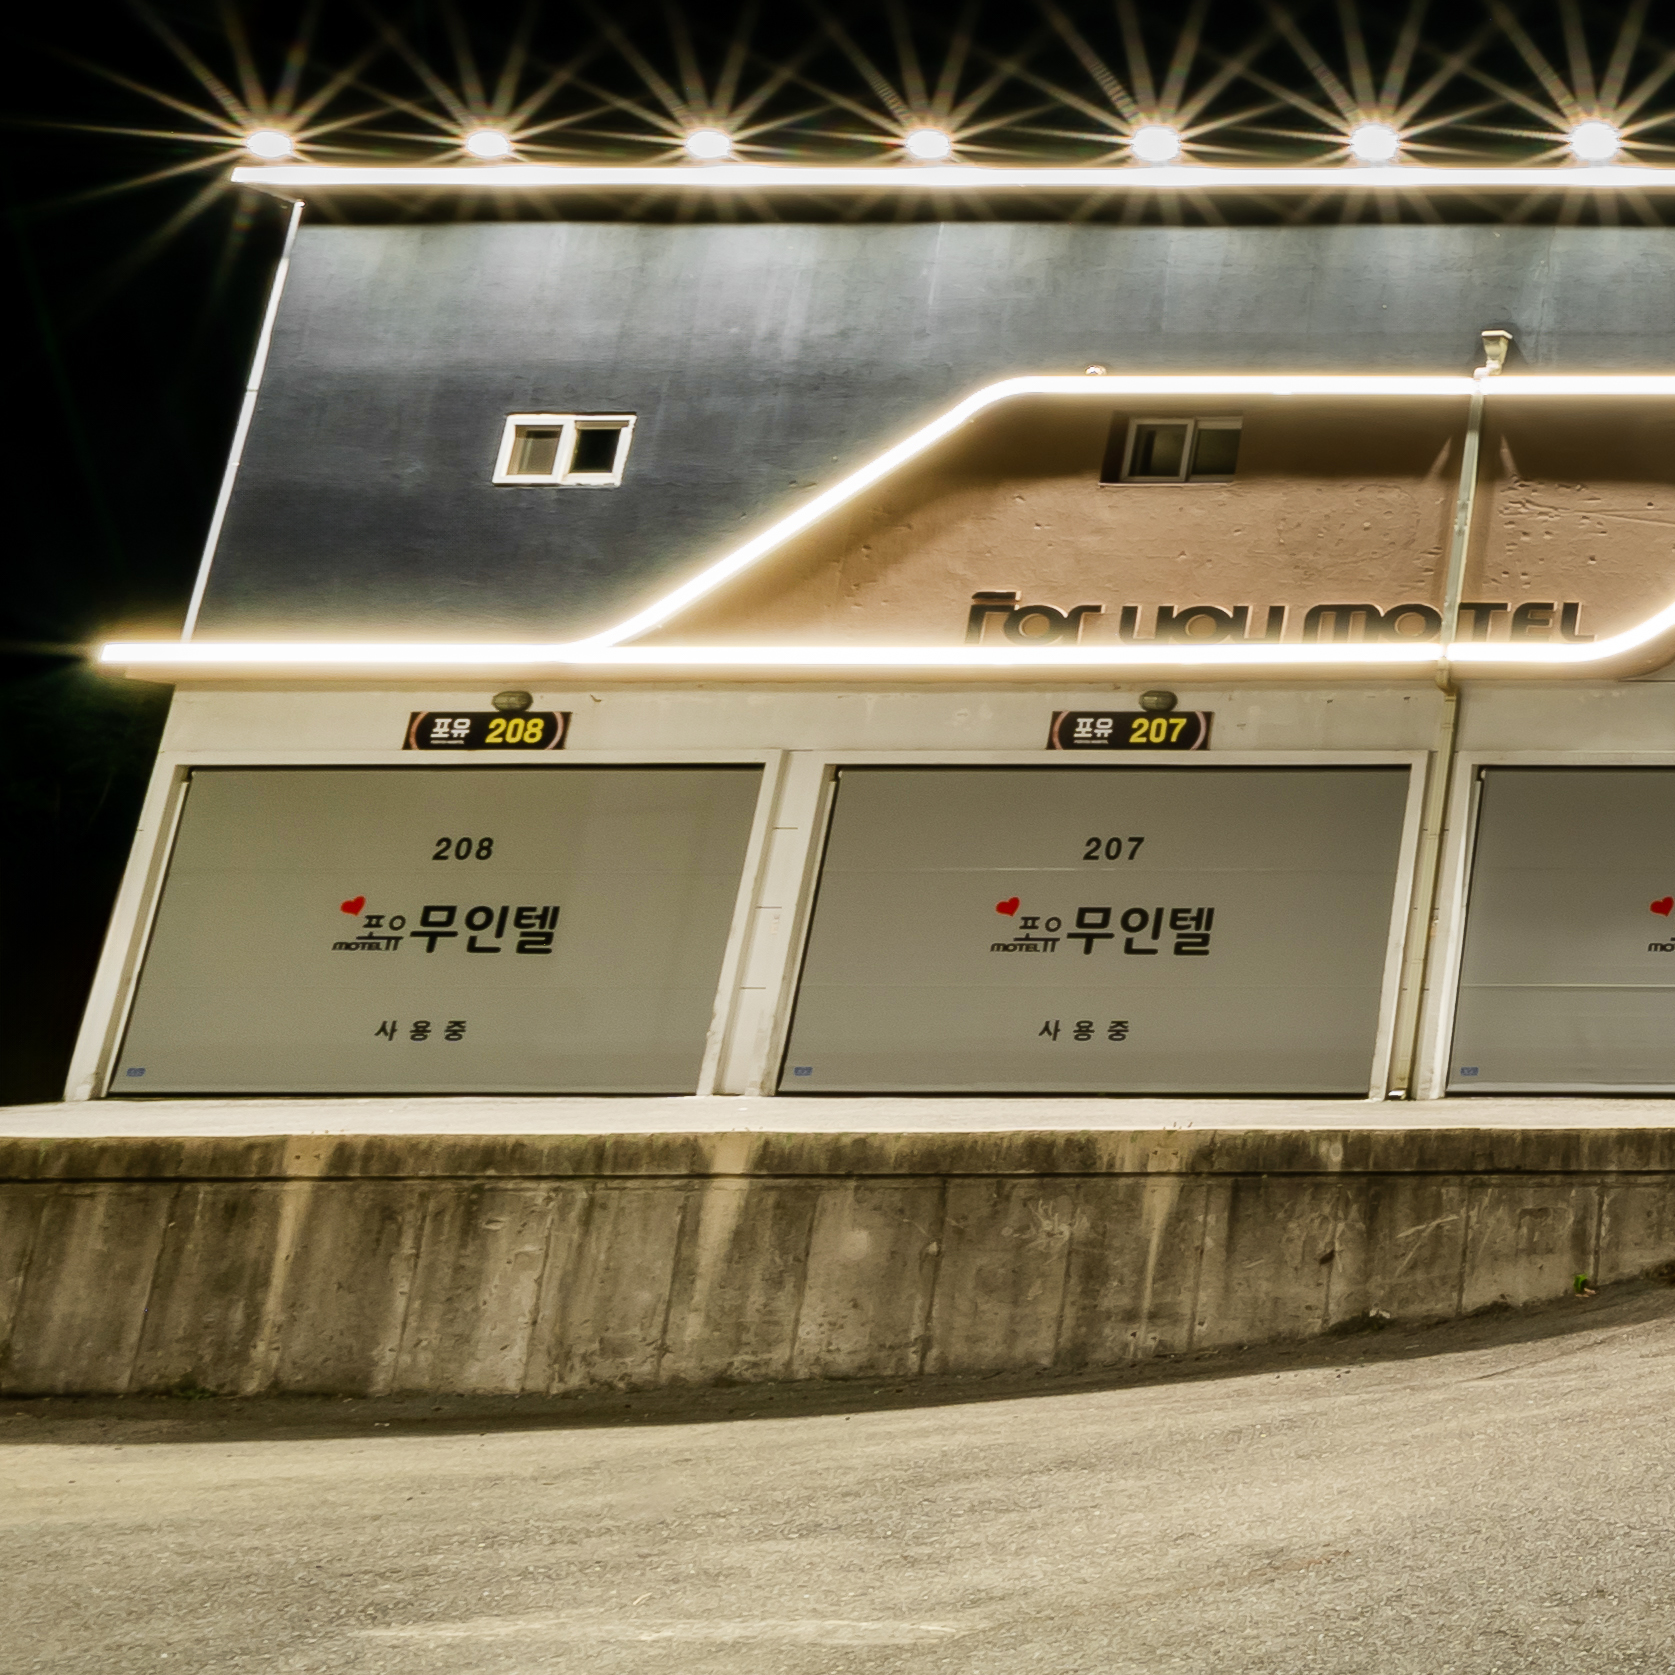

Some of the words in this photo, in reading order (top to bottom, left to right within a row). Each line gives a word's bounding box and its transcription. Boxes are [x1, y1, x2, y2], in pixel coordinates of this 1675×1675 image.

[430, 718, 471, 738] 포유
[485, 718, 545, 744] 208
[1073, 717, 1113, 738] 포유
[1129, 717, 1187, 744] 207
[432, 837, 494, 860] 208
[1083, 836, 1145, 860] 207
[356, 914, 406, 951] 포유
[409, 905, 561, 955] 무인텔
[1013, 916, 1062, 953] 포유
[1066, 907, 1215, 956] 무인텔
